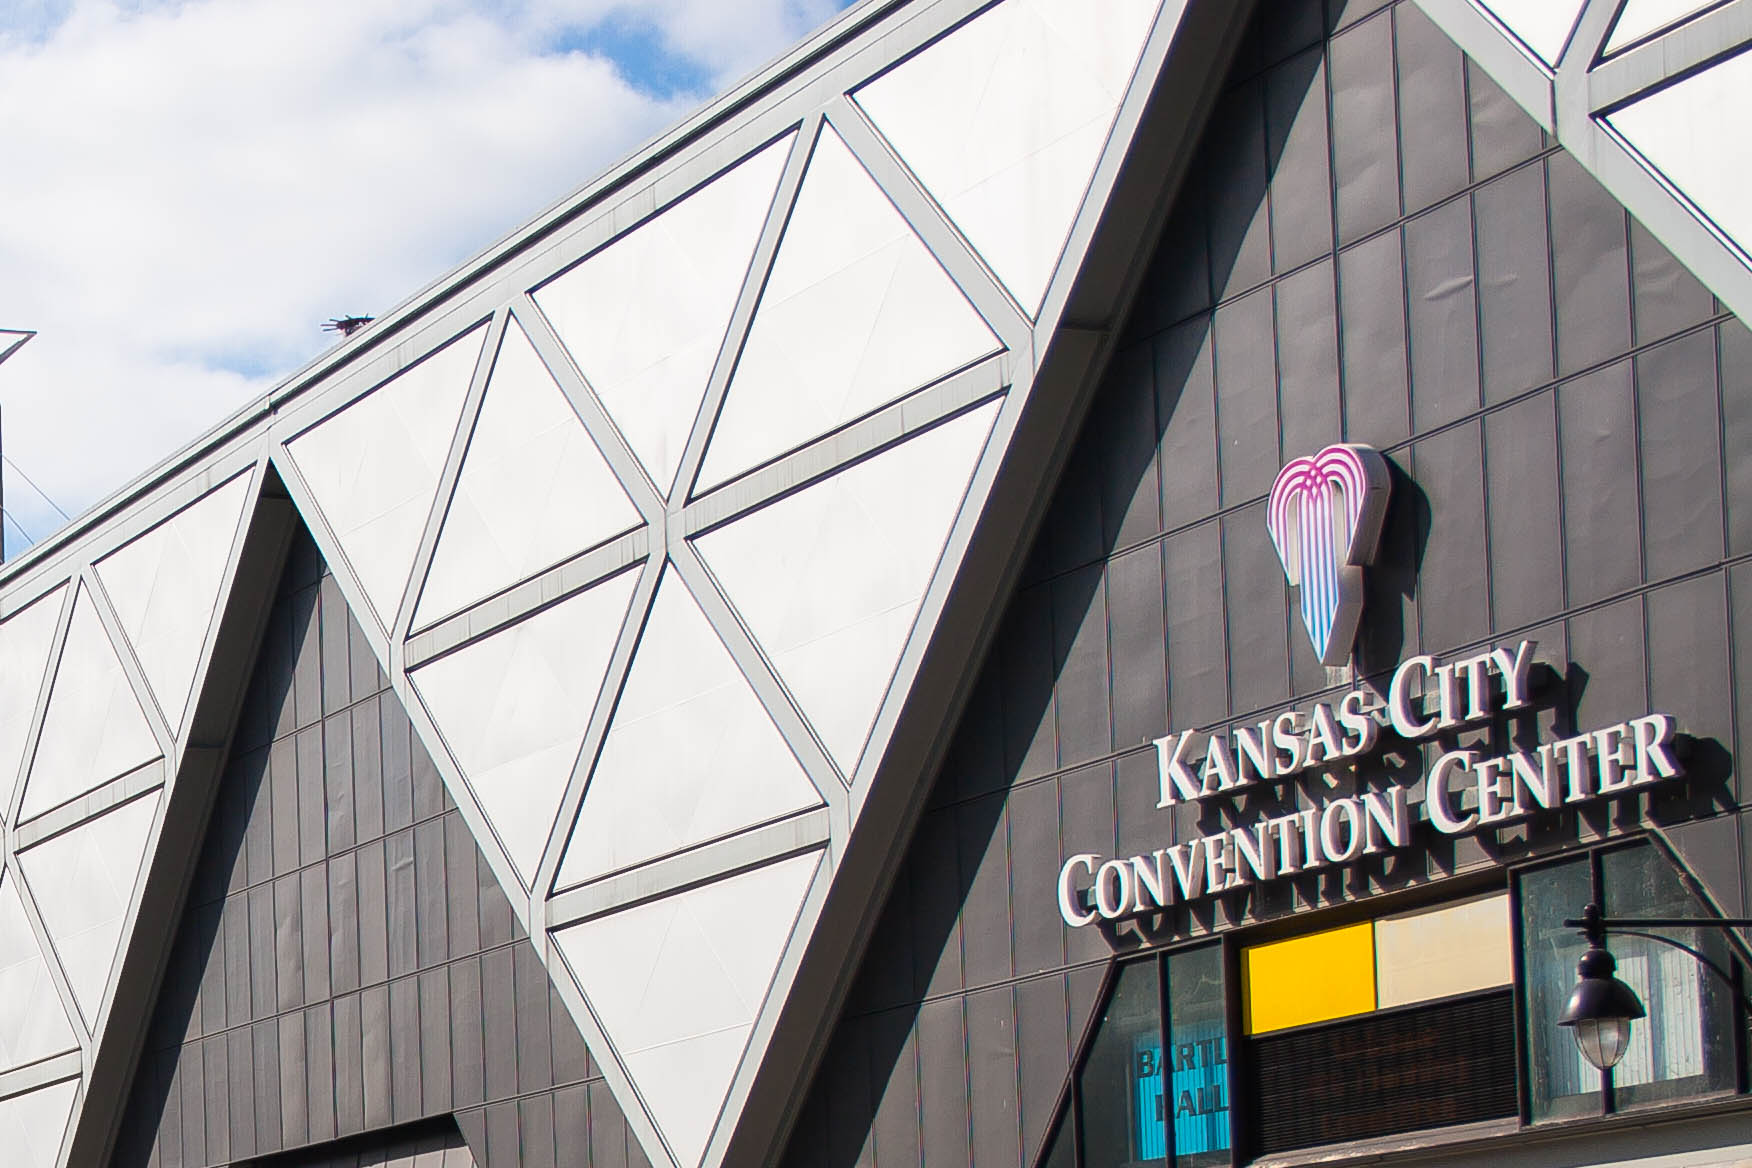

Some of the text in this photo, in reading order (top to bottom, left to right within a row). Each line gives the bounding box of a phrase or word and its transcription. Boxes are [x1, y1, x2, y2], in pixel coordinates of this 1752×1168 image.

[1153, 640, 1538, 808] KANSAS CITY
[1057, 713, 1686, 928] CONVENTION CENTER
